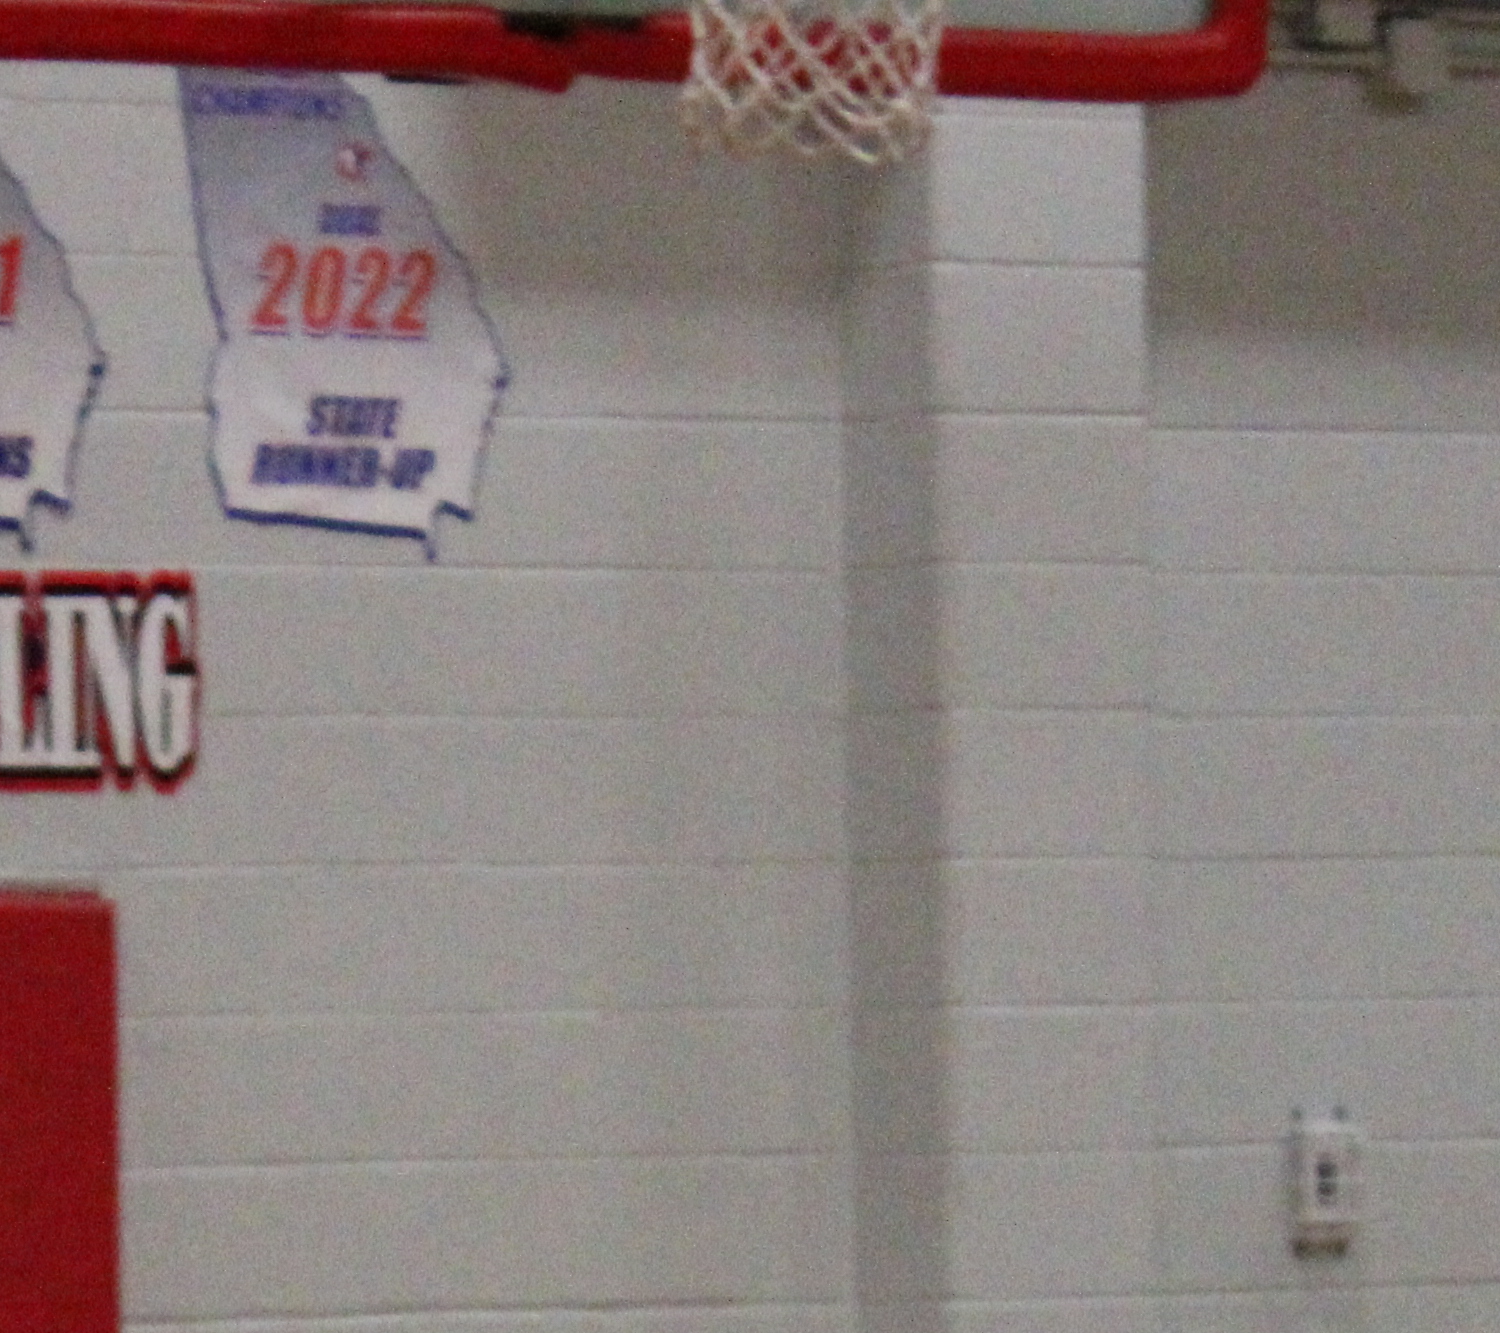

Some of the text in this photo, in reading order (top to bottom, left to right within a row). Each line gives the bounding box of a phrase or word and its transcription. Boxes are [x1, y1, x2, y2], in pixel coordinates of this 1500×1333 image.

[246, 241, 437, 341] 2022
[305, 395, 398, 439] STATE
[250, 443, 437, 489] RUNNER-UP
